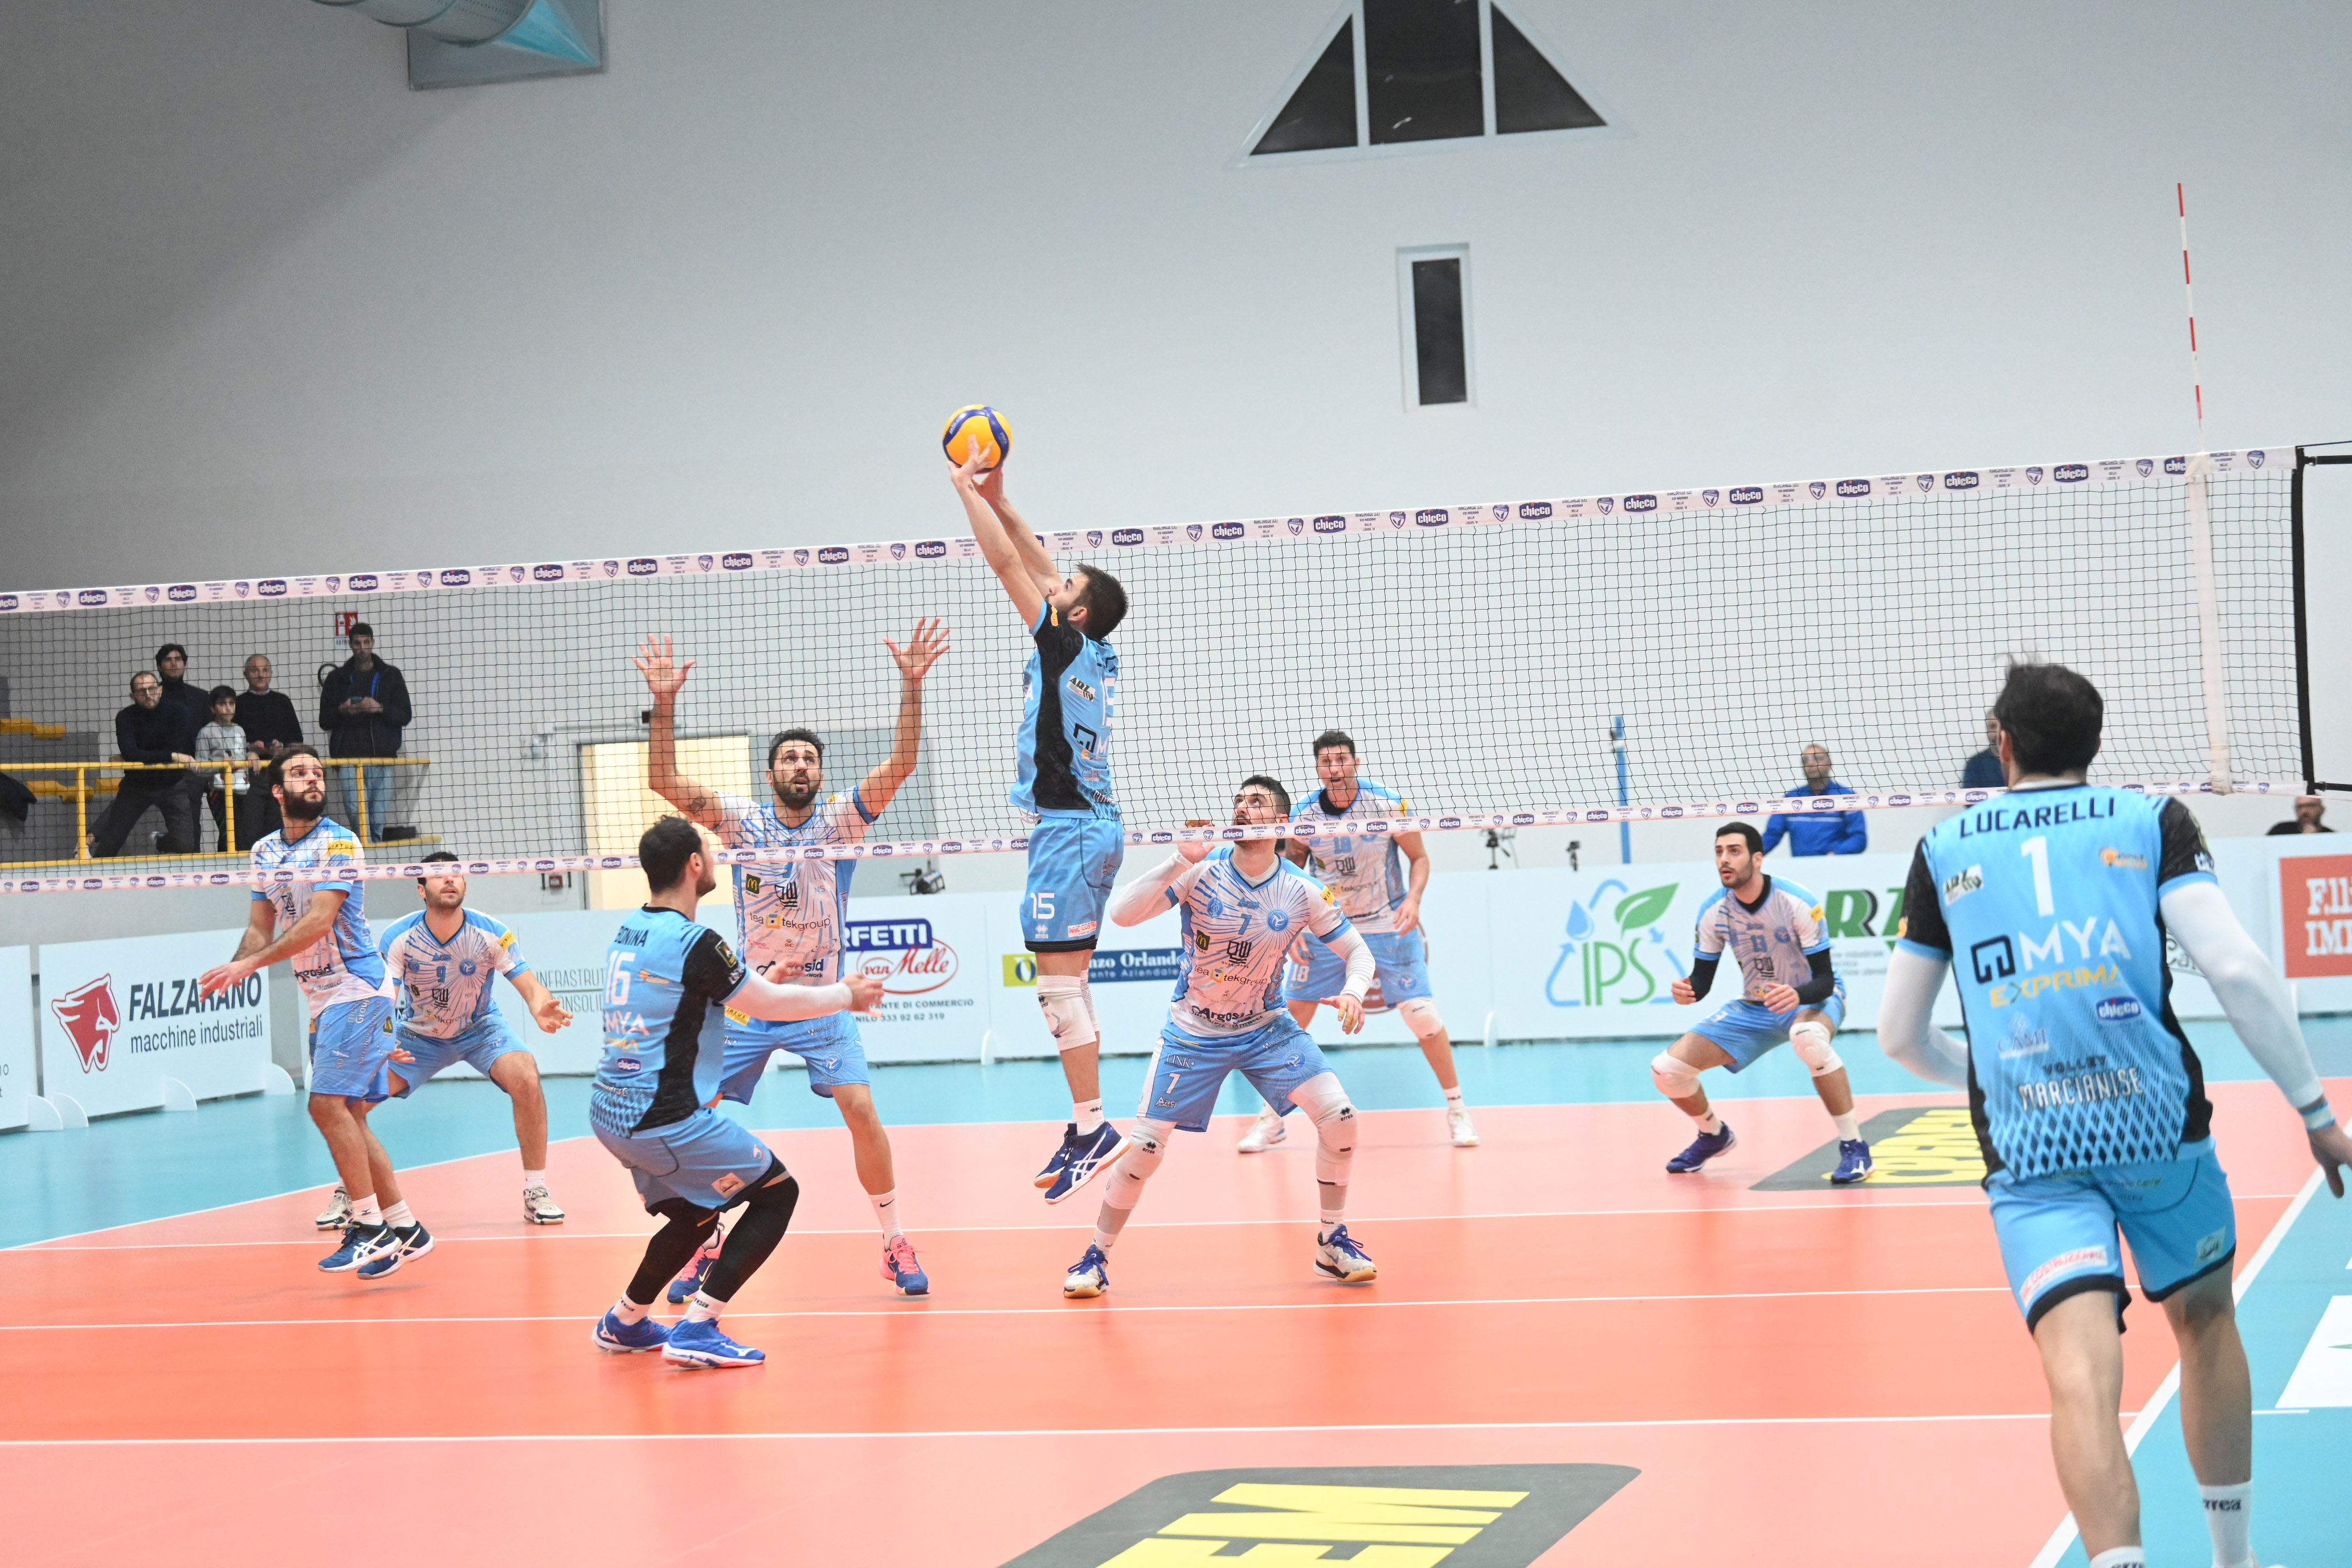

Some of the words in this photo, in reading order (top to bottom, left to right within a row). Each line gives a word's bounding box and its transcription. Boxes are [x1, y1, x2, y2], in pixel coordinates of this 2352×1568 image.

[1946, 471, 1977, 487] chicco
[2057, 464, 2086, 480] chicco
[1838, 479, 1868, 494] chicco
[1626, 495, 1655, 509] chicco
[1732, 487, 1761, 502] chicco
[1418, 509, 1447, 524] chicco
[1521, 502, 1550, 517] chicco
[1214, 522, 1243, 537] chicco
[1316, 516, 1344, 530] chicco
[1115, 529, 1142, 543] chicco
[820, 547, 847, 561] chicco
[917, 542, 945, 556] chicco
[630, 559, 655, 573] chicco
[724, 553, 751, 567] chicco
[443, 570, 468, 583] chicco
[536, 564, 562, 578] chicco
[260, 581, 285, 593] chicco
[350, 575, 376, 589] chicco
[81, 590, 105, 602] chicco
[170, 586, 195, 598] chicco
[1960, 797, 2114, 838] LUCARELLI
[1012, 839, 1028, 848] chicc
[2020, 836, 2054, 918] 1
[1030, 893, 1055, 919] 15
[750, 912, 764, 924] tea
[782, 917, 831, 932] tekgroup
[1238, 913, 1252, 935] 7
[614, 926, 650, 947] BONINA
[2019, 916, 2131, 972] MYA
[865, 962, 889, 976] van
[896, 945, 950, 975] Melle
[436, 966, 446, 983] 9
[1195, 965, 1210, 975] tea
[1291, 964, 1309, 983] 18
[1581, 938, 1656, 1006] IPS
[606, 950, 636, 1006] 16
[916, 999, 974, 1008] COMMERCIO
[2098, 999, 2139, 1018] chicco
[928, 1012, 944, 1020] 319
[130, 1024, 196, 1053] macchine
[200, 1015, 263, 1043] industriali
[1997, 1028, 2047, 1051] CAMI
[1166, 1053, 1191, 1068] LINK
[2043, 1055, 2106, 1075] VOLLEY
[1166, 1073, 1181, 1094] 7
[2019, 1067, 2143, 1111] MARCIANISE
